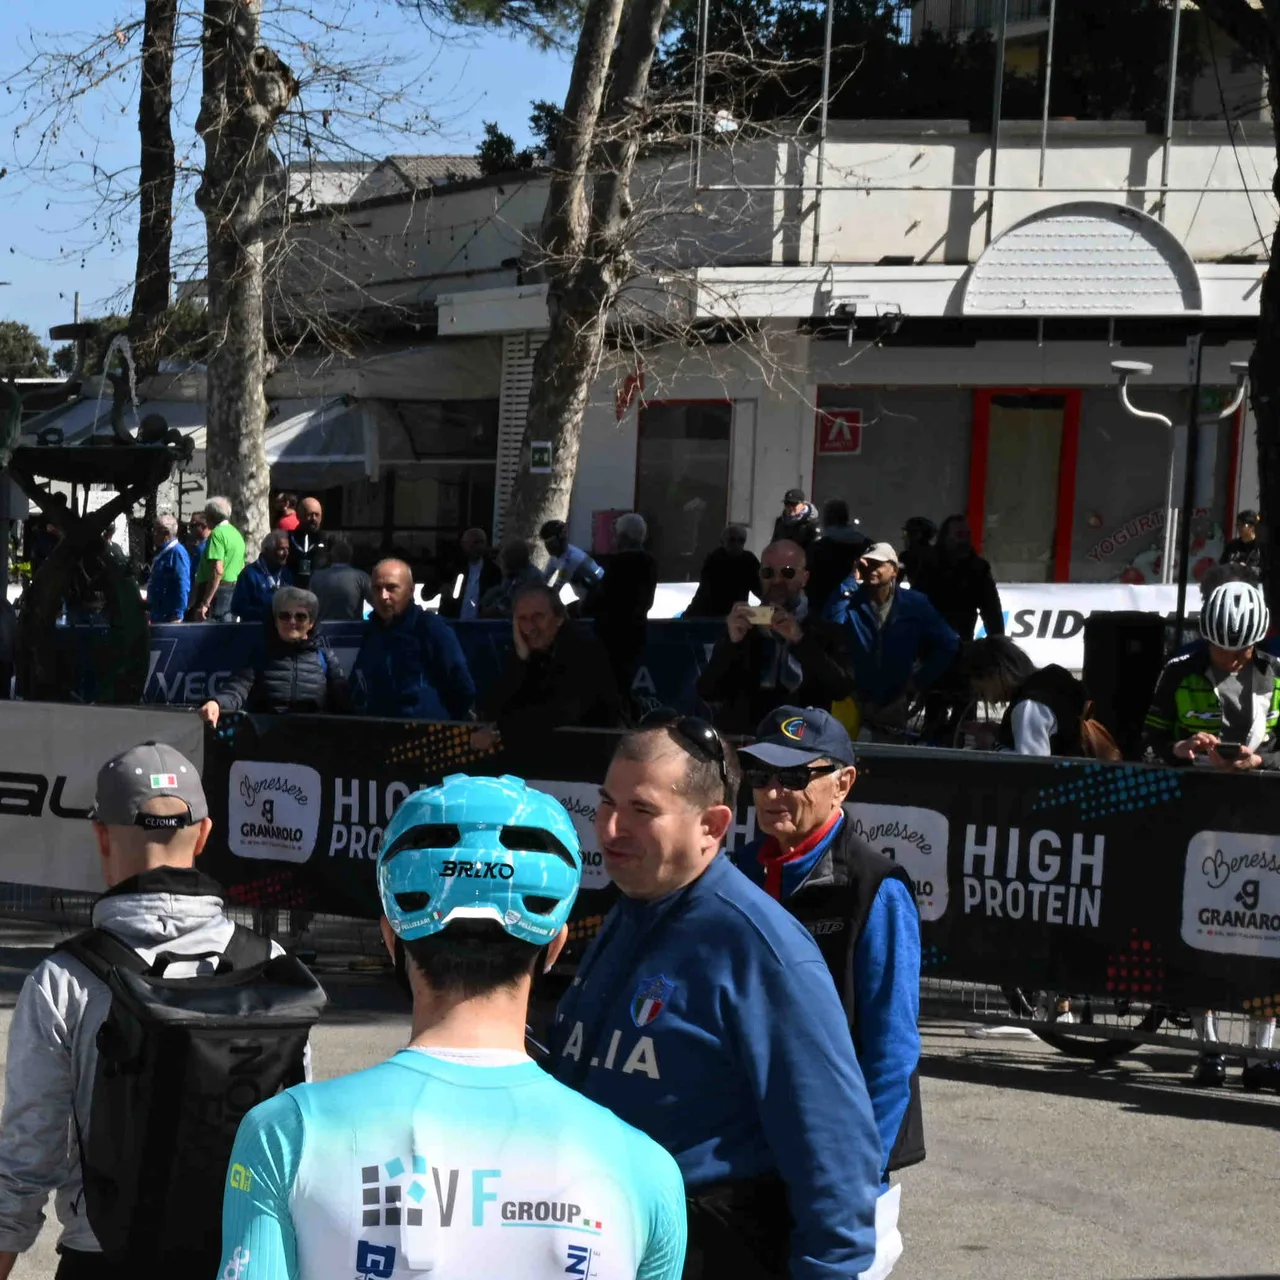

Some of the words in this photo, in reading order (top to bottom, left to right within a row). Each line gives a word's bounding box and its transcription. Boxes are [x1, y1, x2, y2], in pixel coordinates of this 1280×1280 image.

[241, 823, 303, 842] GRANAROLO
[963, 824, 1107, 887] HIGH
[440, 860, 514, 880] BRIKO
[963, 877, 1103, 928] PROTEIN
[501, 1200, 581, 1223] GROUP
